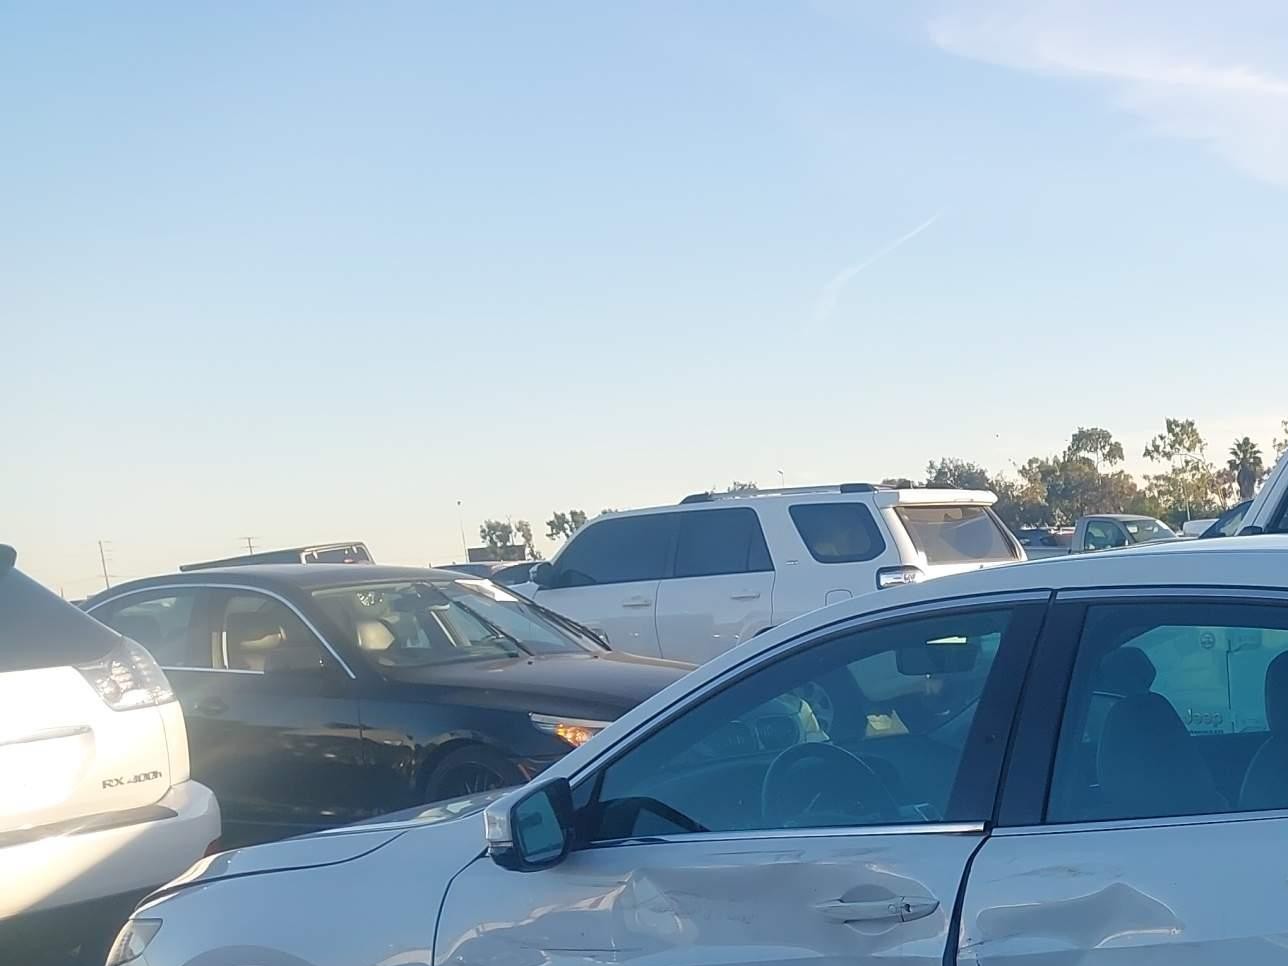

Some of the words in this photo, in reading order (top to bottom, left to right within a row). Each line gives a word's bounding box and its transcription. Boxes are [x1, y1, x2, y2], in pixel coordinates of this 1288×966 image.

[1184, 708, 1223, 728] Jeep
[102, 776, 125, 789] RX
[127, 770, 162, 784] 400h
